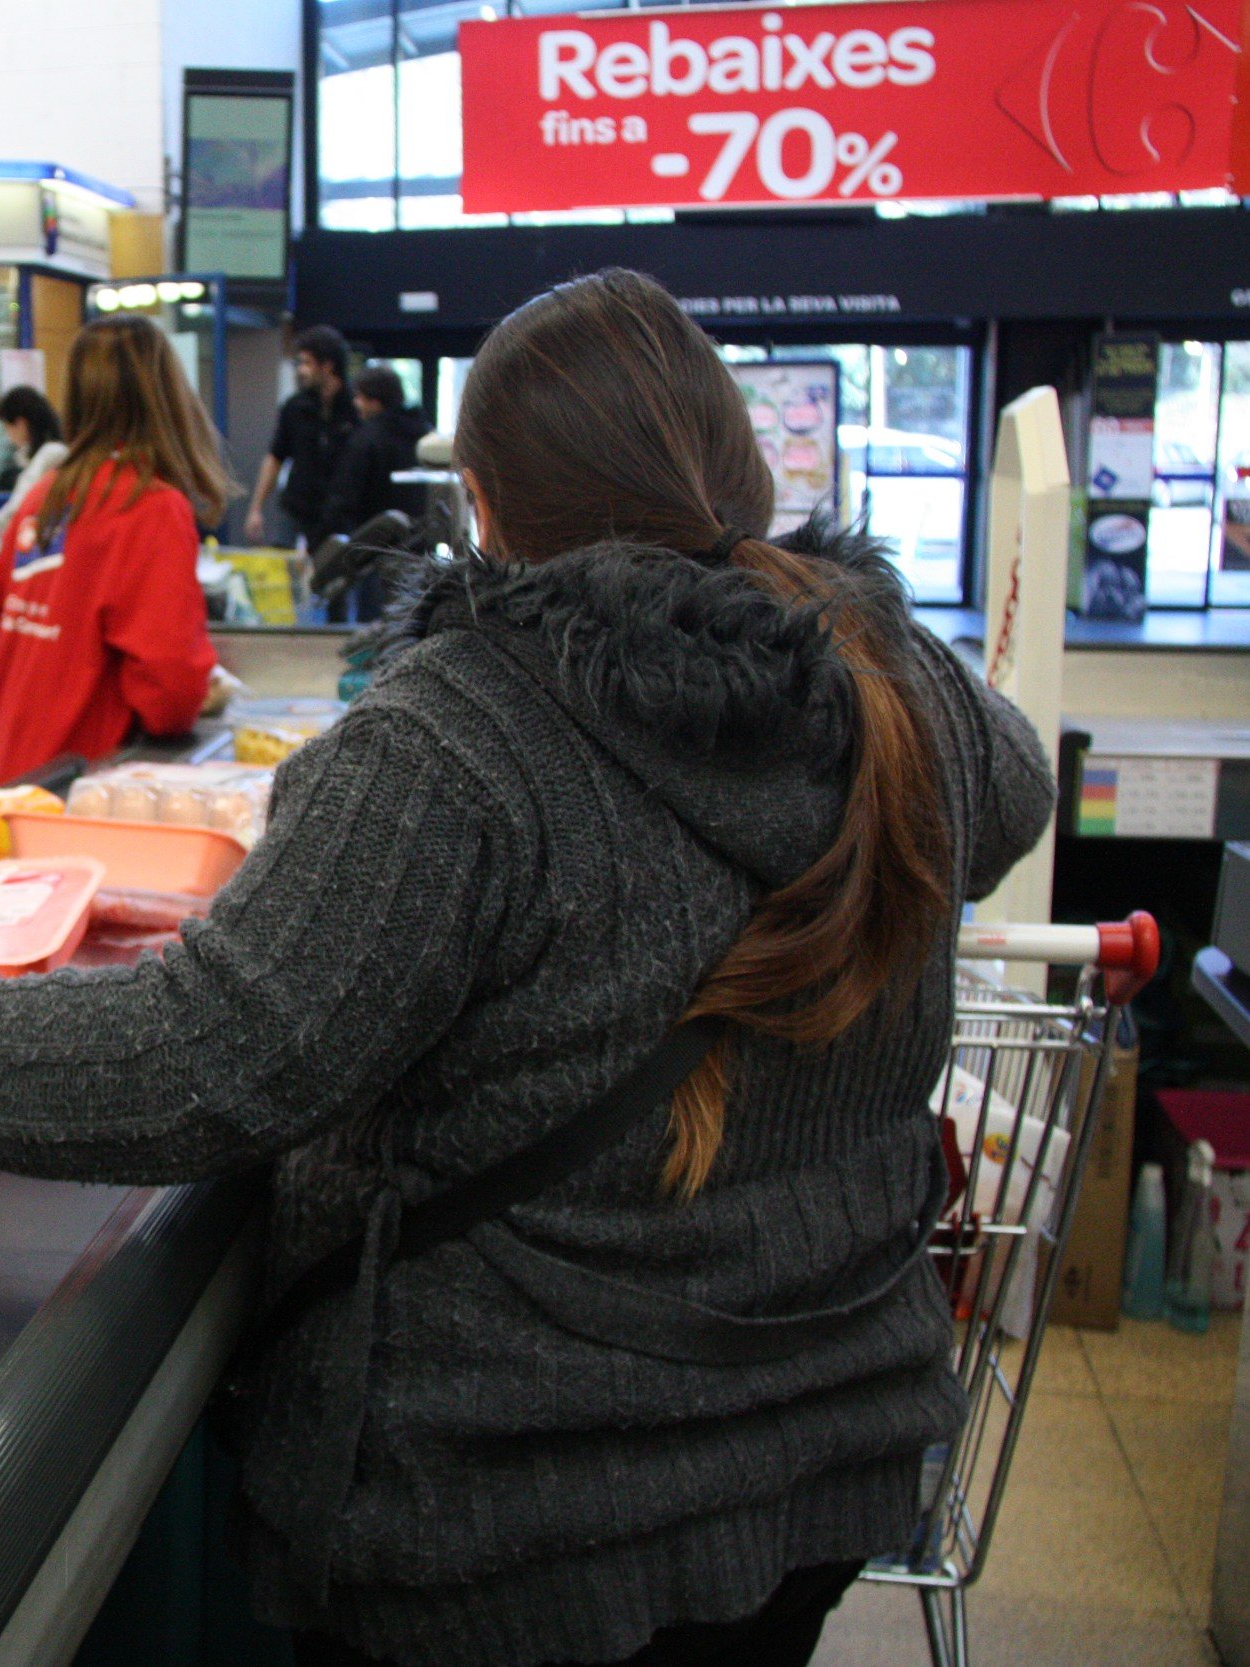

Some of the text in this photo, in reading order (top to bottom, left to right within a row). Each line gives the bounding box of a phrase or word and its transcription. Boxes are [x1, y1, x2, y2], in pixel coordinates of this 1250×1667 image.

[538, 17, 935, 100] Rebaixes
[539, 111, 647, 146] fins a
[651, 107, 903, 199] -70%
